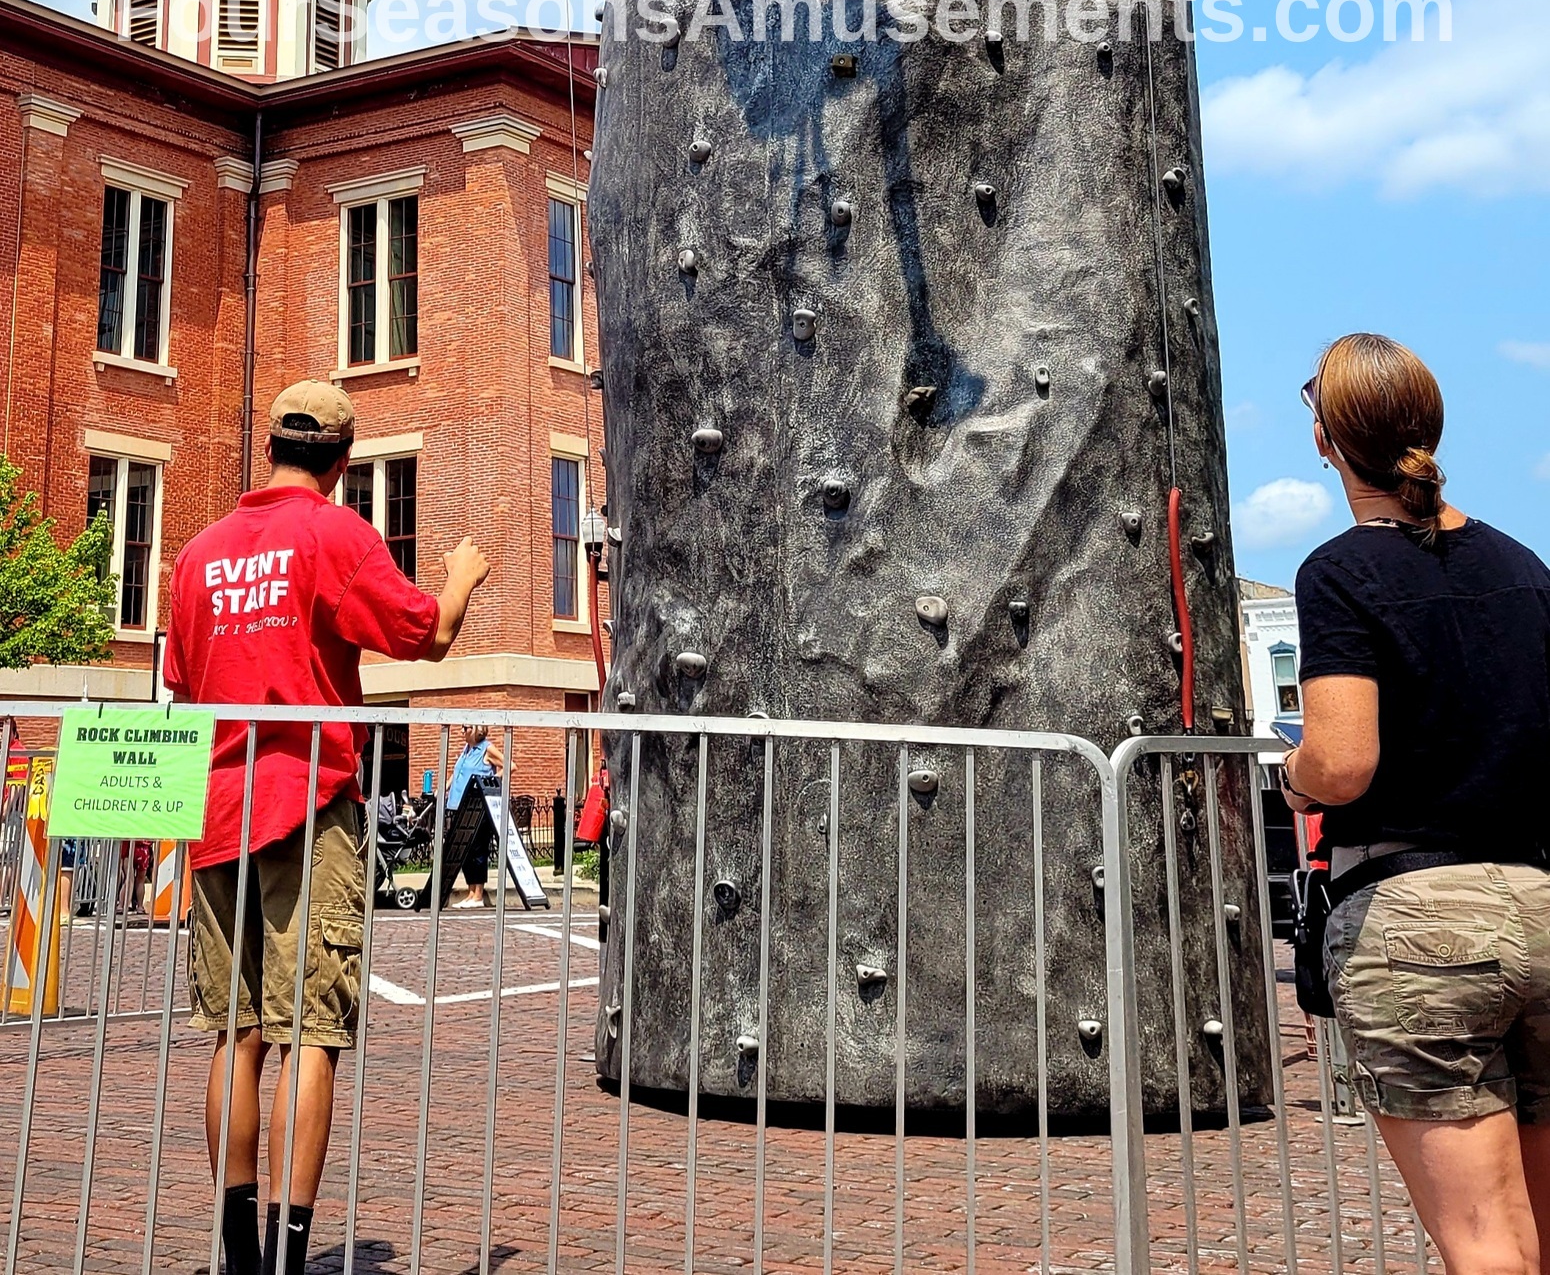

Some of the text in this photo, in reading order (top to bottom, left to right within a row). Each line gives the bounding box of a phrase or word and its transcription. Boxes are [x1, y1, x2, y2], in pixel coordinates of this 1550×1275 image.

[205, 549, 294, 588] EVENT
[211, 580, 289, 616] STAFF
[233, 624, 240, 635] I
[76, 727, 199, 744] ROCK CLIMBING
[112, 751, 158, 765] WALL
[100, 775, 162, 789] ADULTS &
[74, 798, 184, 813] CHILDREN 7 & UP
